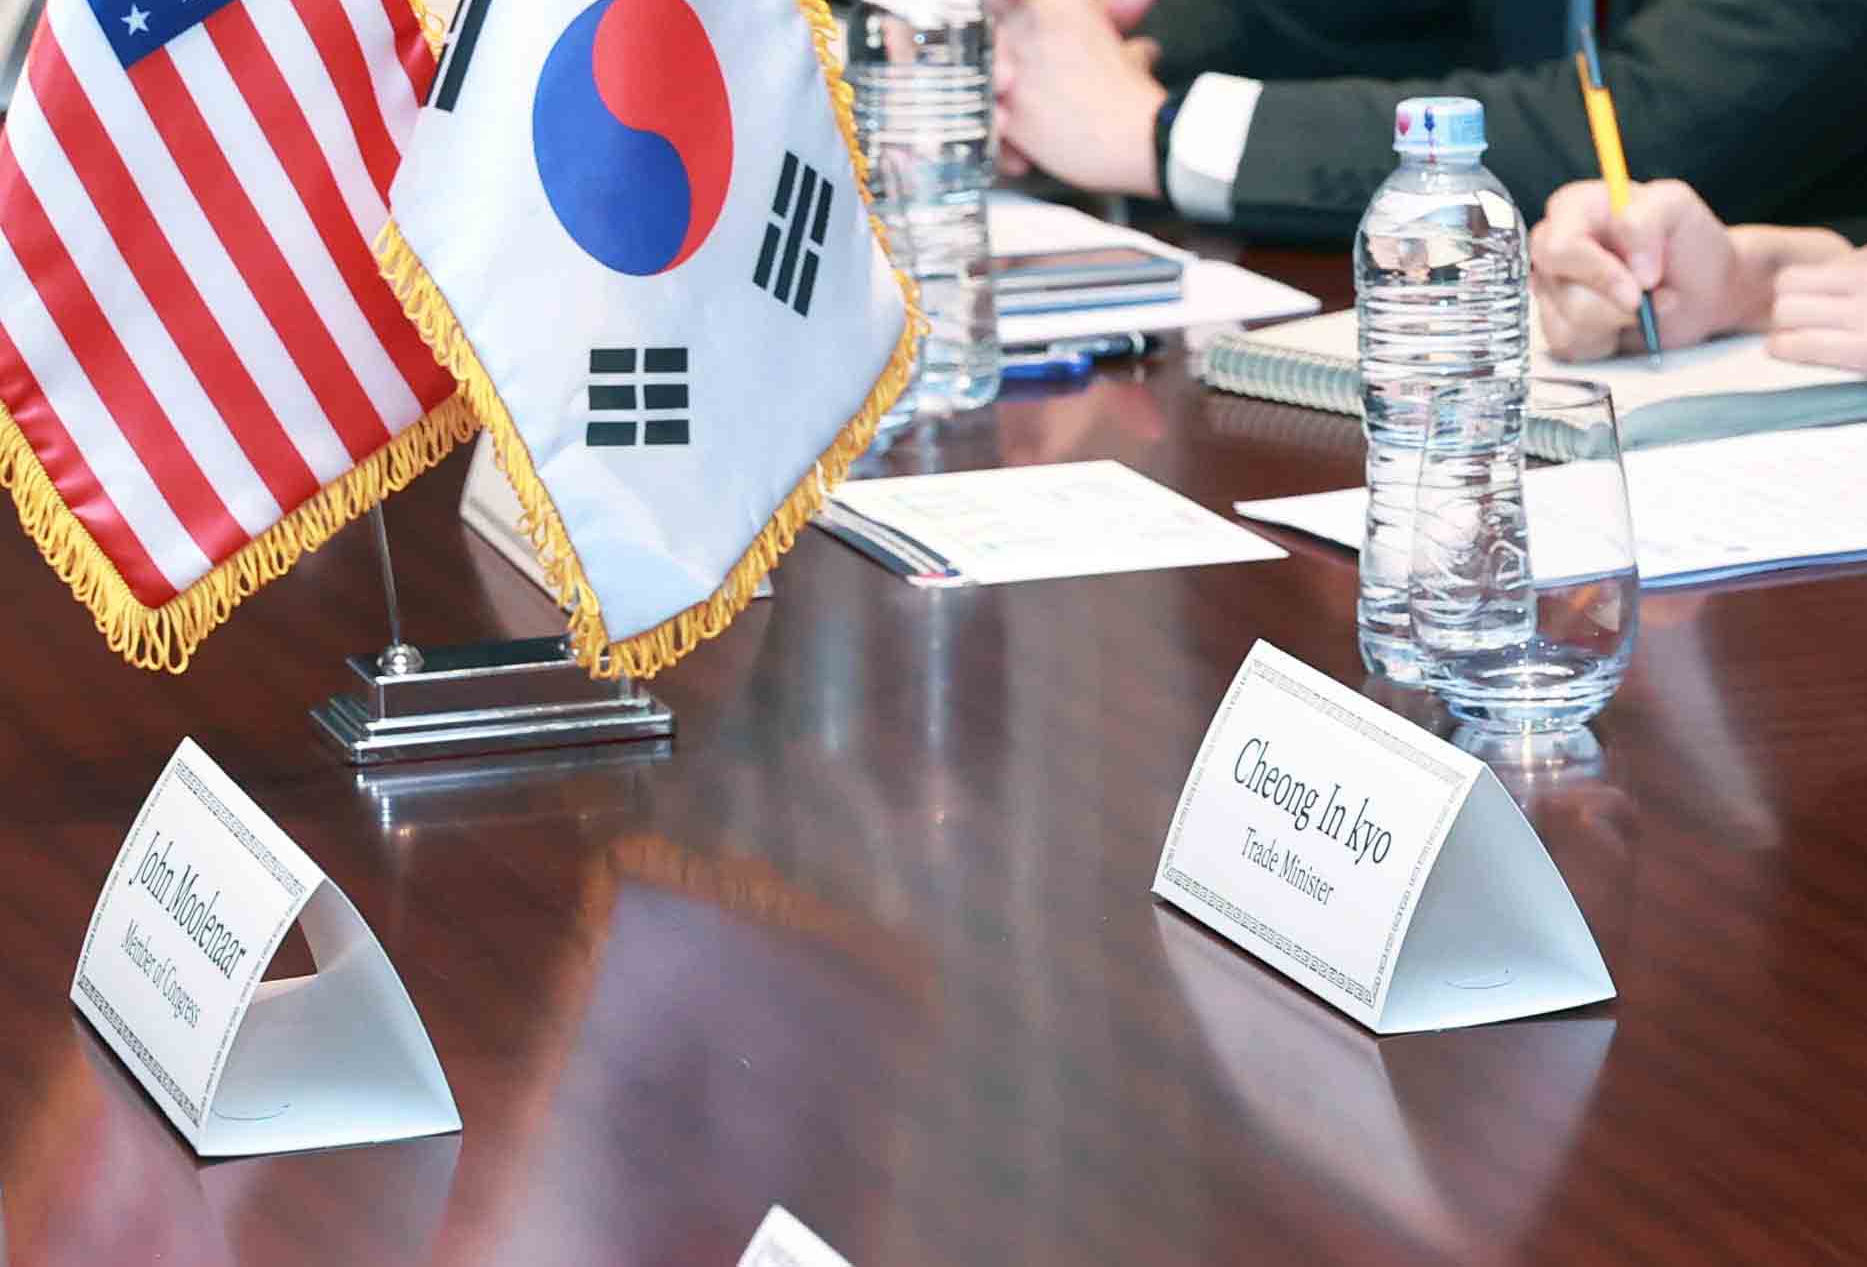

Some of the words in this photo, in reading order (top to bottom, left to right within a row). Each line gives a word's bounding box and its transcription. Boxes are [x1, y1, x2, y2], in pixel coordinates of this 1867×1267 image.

[1234, 737, 1319, 831] Cheong
[1316, 783, 1346, 840] In
[1344, 797, 1392, 866] kyo
[1241, 826, 1279, 872] Trade
[1278, 849, 1334, 906] Minister
[128, 831, 175, 904] John
[165, 864, 247, 980] Moolenaar
[121, 917, 157, 977] Member
[152, 957, 173, 989] of
[162, 965, 201, 1028] Congress
